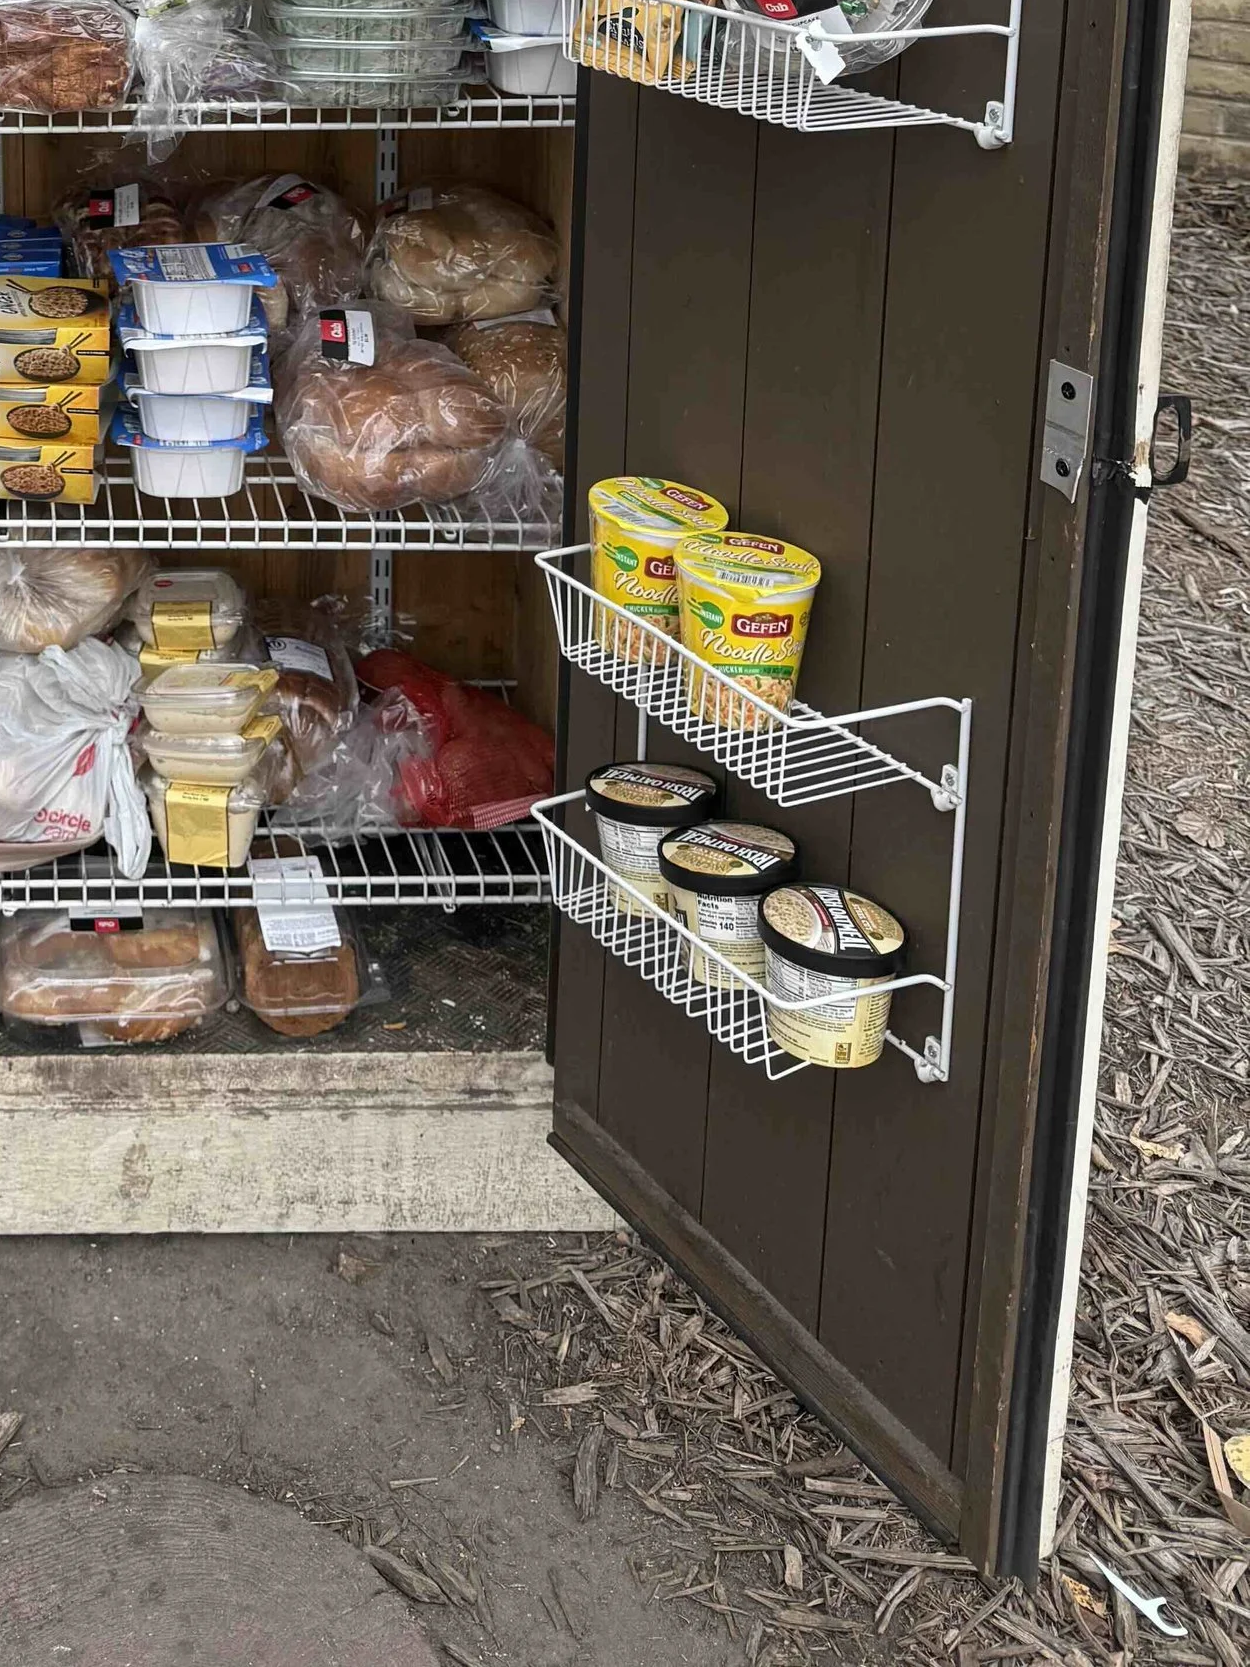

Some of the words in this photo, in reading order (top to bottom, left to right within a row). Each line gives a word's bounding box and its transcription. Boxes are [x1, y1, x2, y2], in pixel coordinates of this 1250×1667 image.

[766, 3, 788, 12] Cub
[330, 323, 343, 338] Cub
[666, 489, 709, 510] GEFEN
[728, 537, 780, 552] GEFEN
[736, 618, 788, 633] GEFEN
[700, 628, 773, 663] Noodle
[600, 768, 664, 789] OATMEAL
[664, 781, 706, 801] IRISH
[49, 809, 91, 832] circle
[676, 829, 741, 855] OATMEAL
[740, 847, 781, 871] IRISH
[697, 893, 733, 903] Nutrition
[698, 900, 719, 910] Facts
[719, 923, 735, 931] 140
[828, 906, 874, 951] OATMEAL
